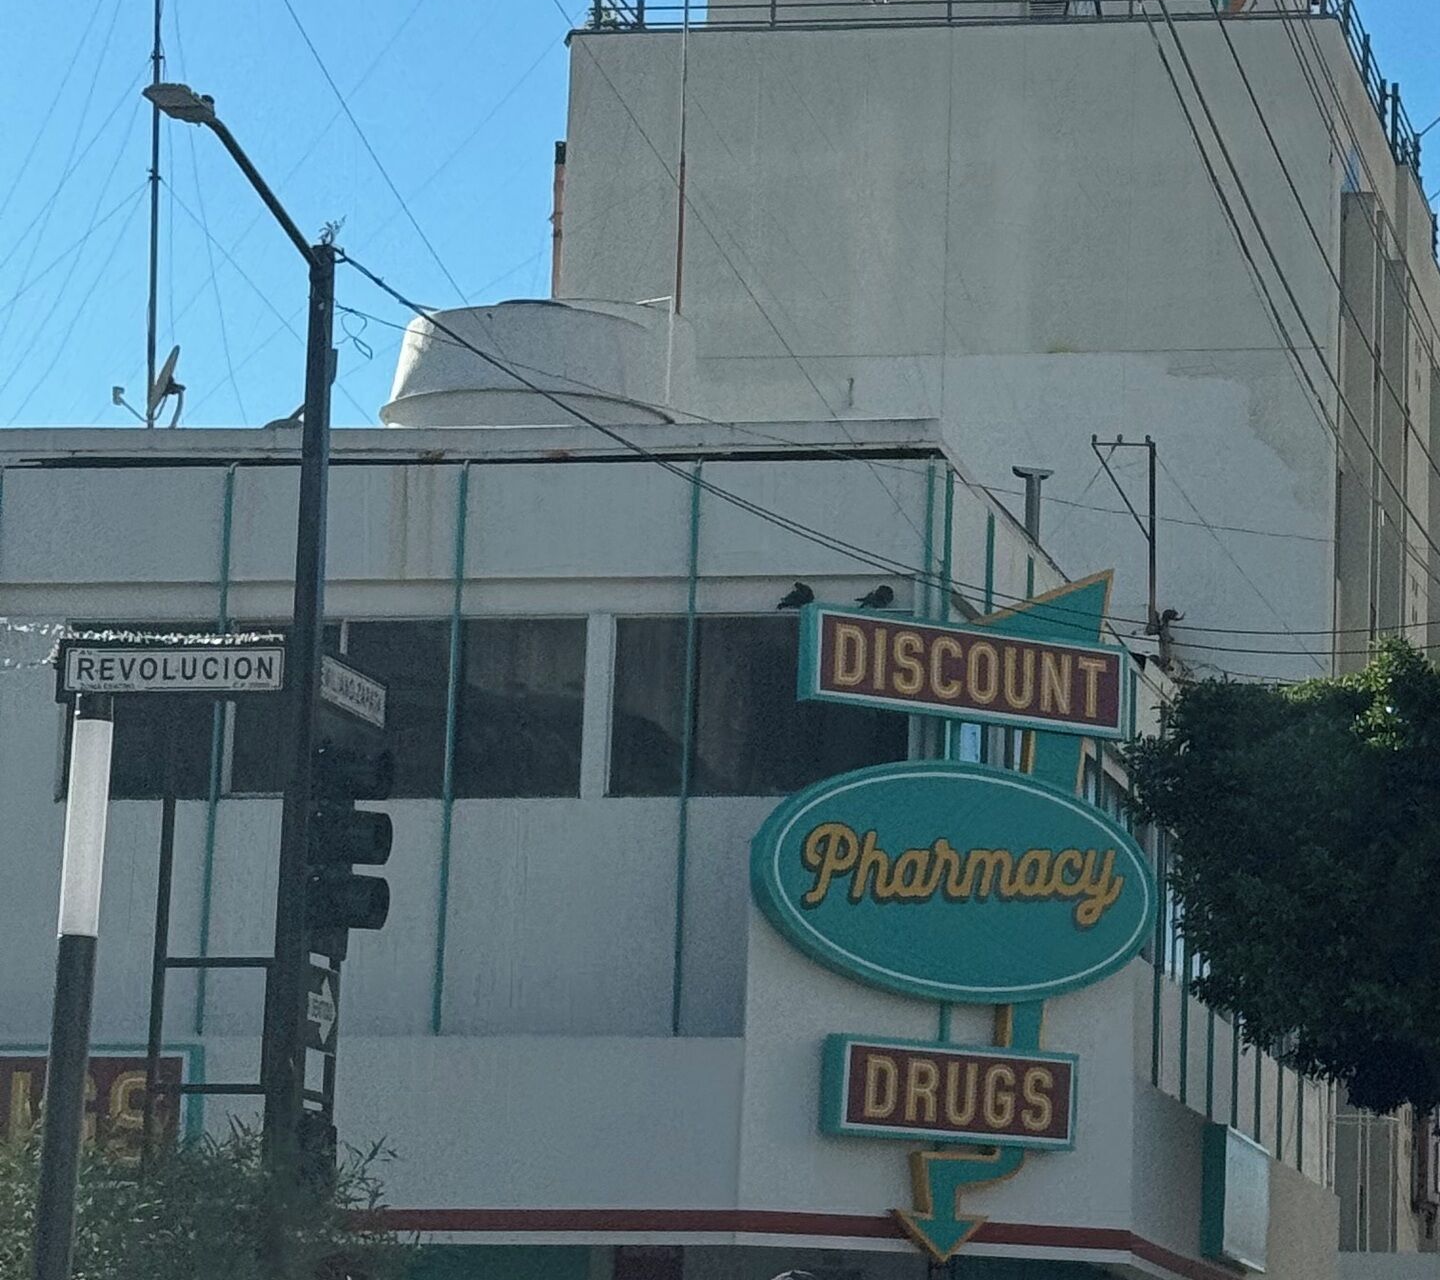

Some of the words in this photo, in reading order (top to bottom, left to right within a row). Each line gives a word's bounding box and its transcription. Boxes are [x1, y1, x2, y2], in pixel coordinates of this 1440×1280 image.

[76, 656, 274, 681] REVOLUCION
[832, 621, 1109, 718] DISCOUNT
[803, 821, 1124, 928] Pharmacy
[864, 1053, 1054, 1132] DRUGS
